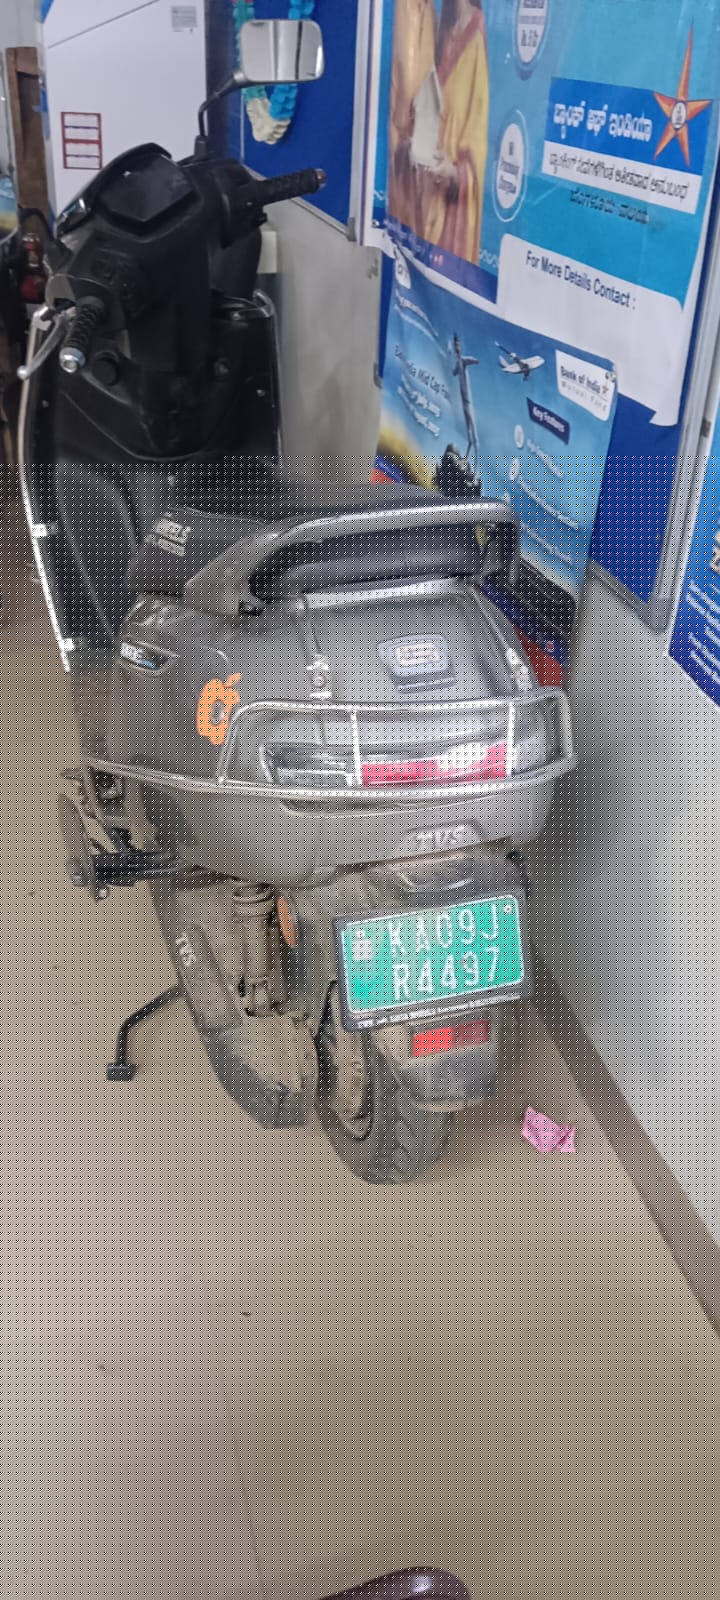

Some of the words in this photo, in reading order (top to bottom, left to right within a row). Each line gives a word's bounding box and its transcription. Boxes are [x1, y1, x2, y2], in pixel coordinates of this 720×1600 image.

[526, 250, 540, 268] For
[541, 256, 562, 278] More
[564, 265, 591, 291] Details
[593, 278, 631, 308] Contact
[560, 364, 577, 382] Bank
[578, 372, 585, 386] of
[585, 375, 602, 394] India
[415, 825, 465, 850] TVS
[176, 932, 197, 967] TVS
[388, 903, 500, 958] KA09J
[392, 946, 500, 1001] R4497
